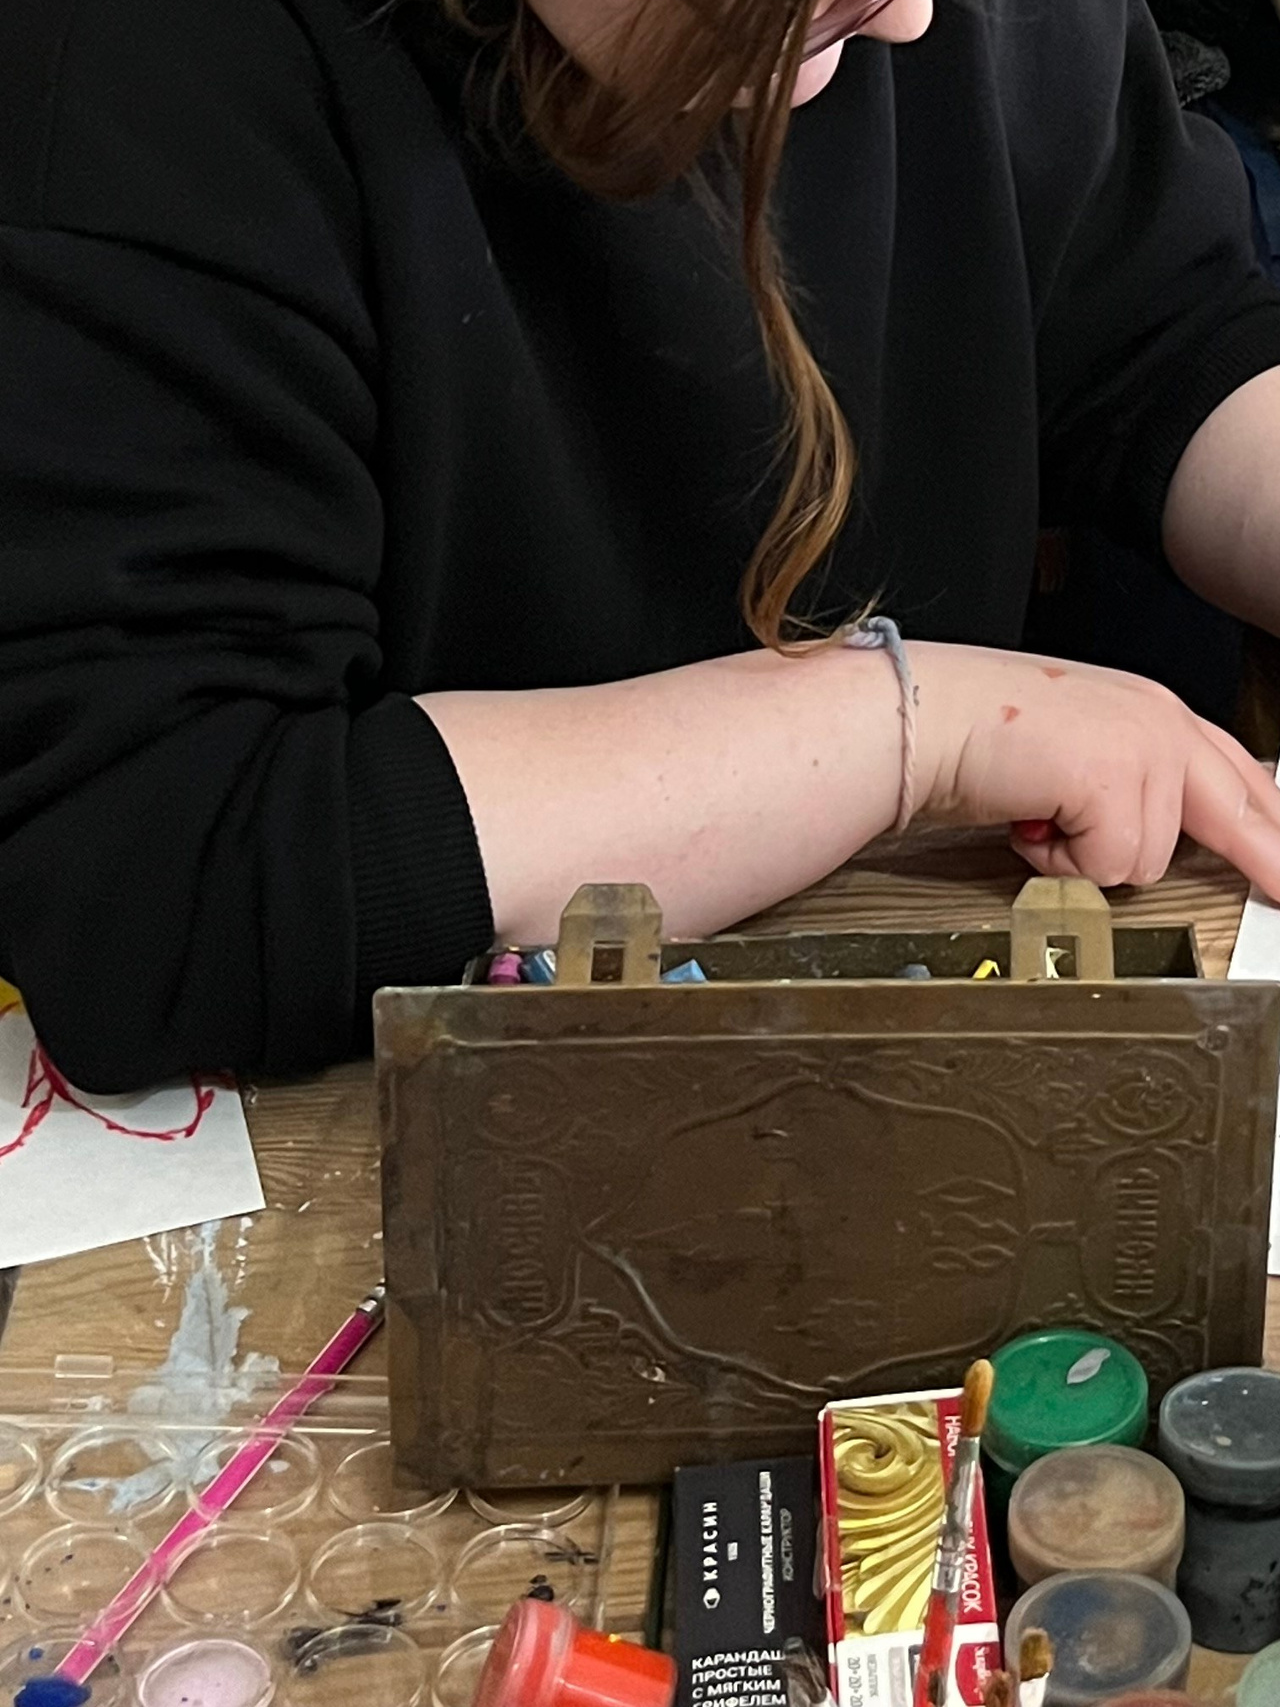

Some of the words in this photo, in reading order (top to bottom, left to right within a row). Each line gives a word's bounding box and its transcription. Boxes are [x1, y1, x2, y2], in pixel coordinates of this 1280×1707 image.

[703, 1502, 719, 1582] КРАСИН
[691, 1649, 787, 1670] КАРАНДАШ
[691, 1664, 773, 1685] ПРОСТЫЕ
[706, 1679, 781, 1696] МЯГКИМ
